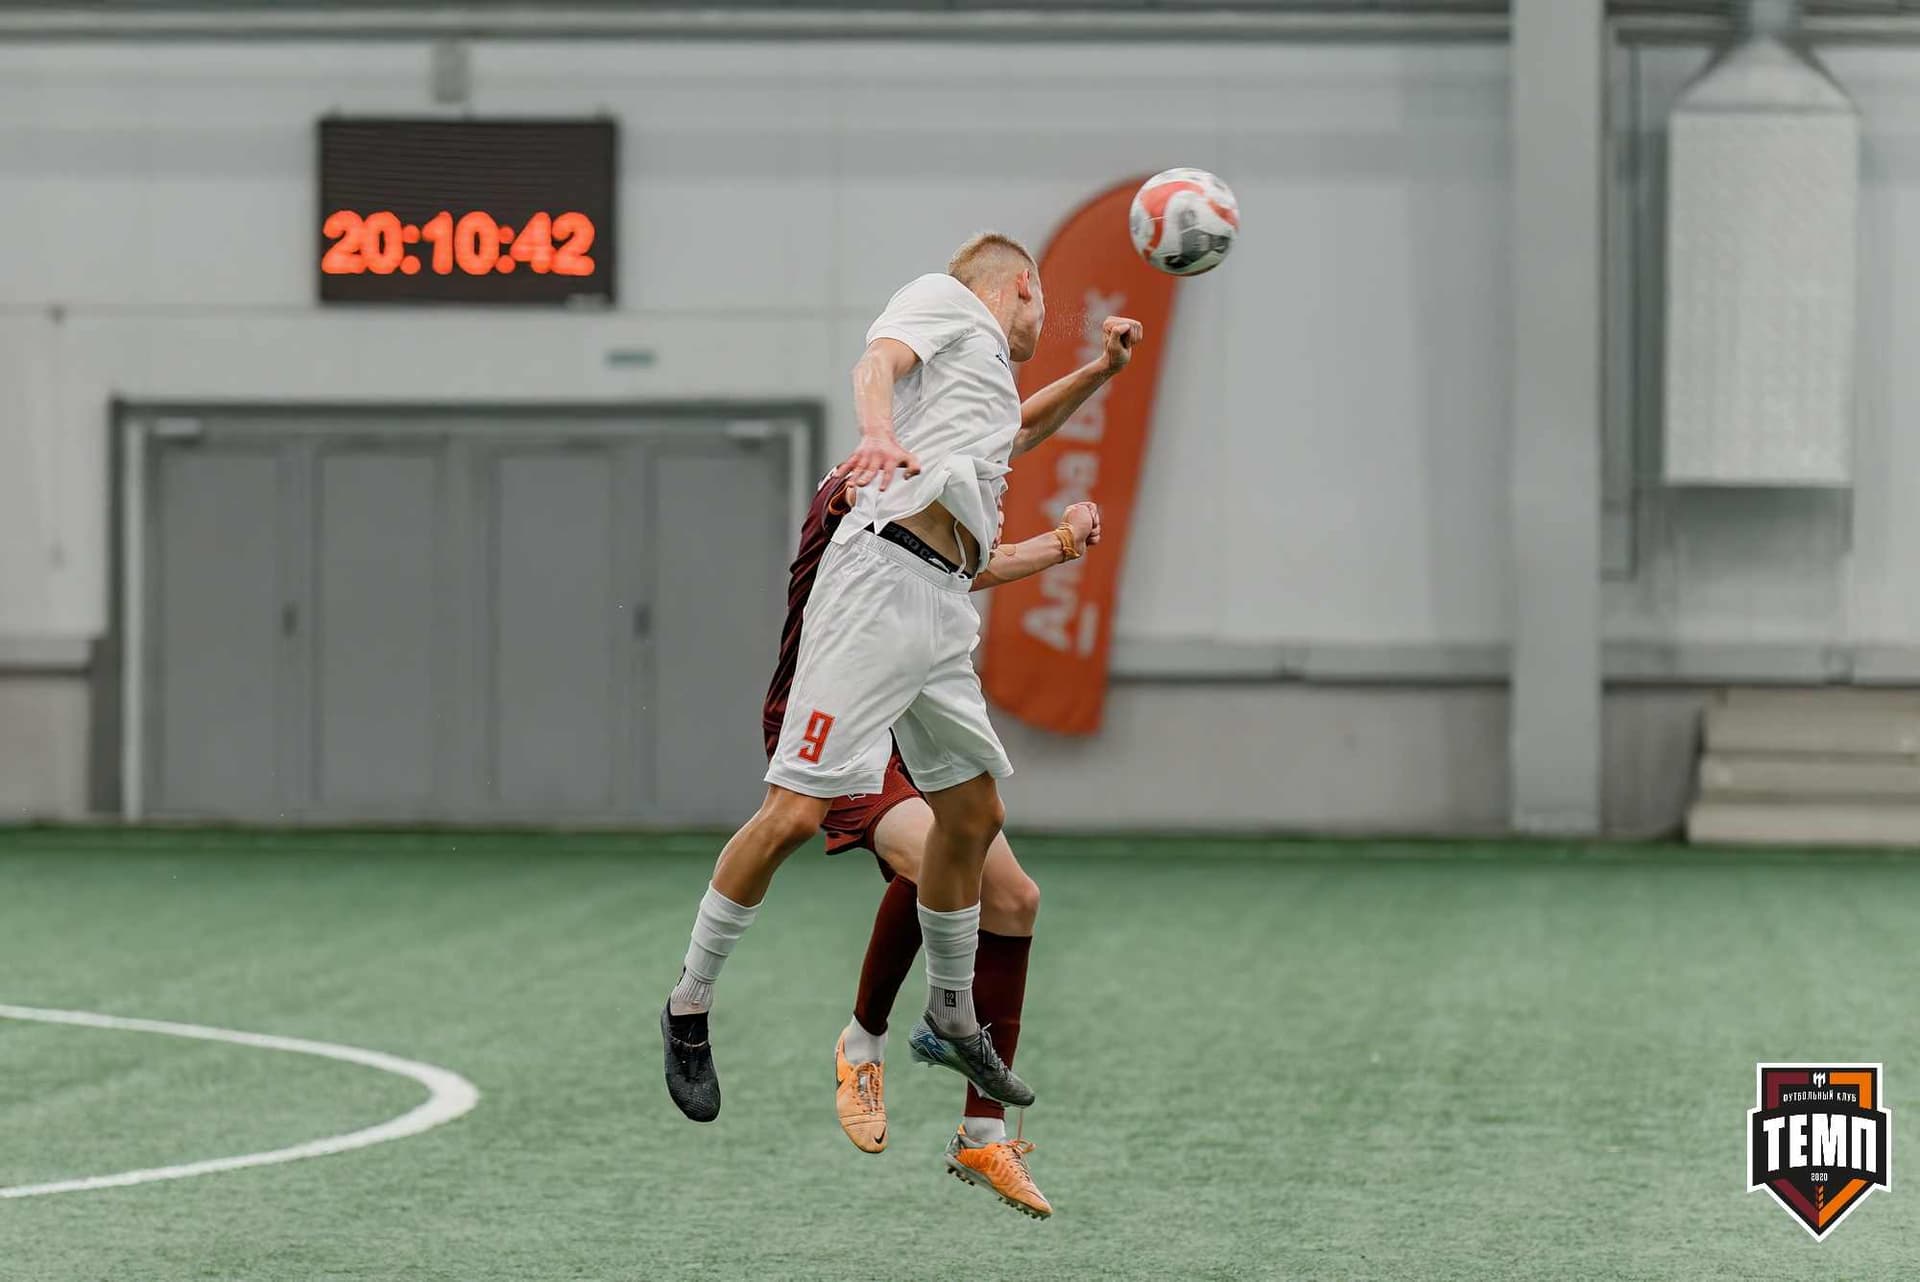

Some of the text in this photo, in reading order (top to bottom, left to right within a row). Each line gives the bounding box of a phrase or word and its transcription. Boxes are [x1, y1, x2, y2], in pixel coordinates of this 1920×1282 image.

[321, 210, 595, 276] 20:10:42
[1020, 453, 1101, 653] Ала
[798, 709, 835, 764] 9
